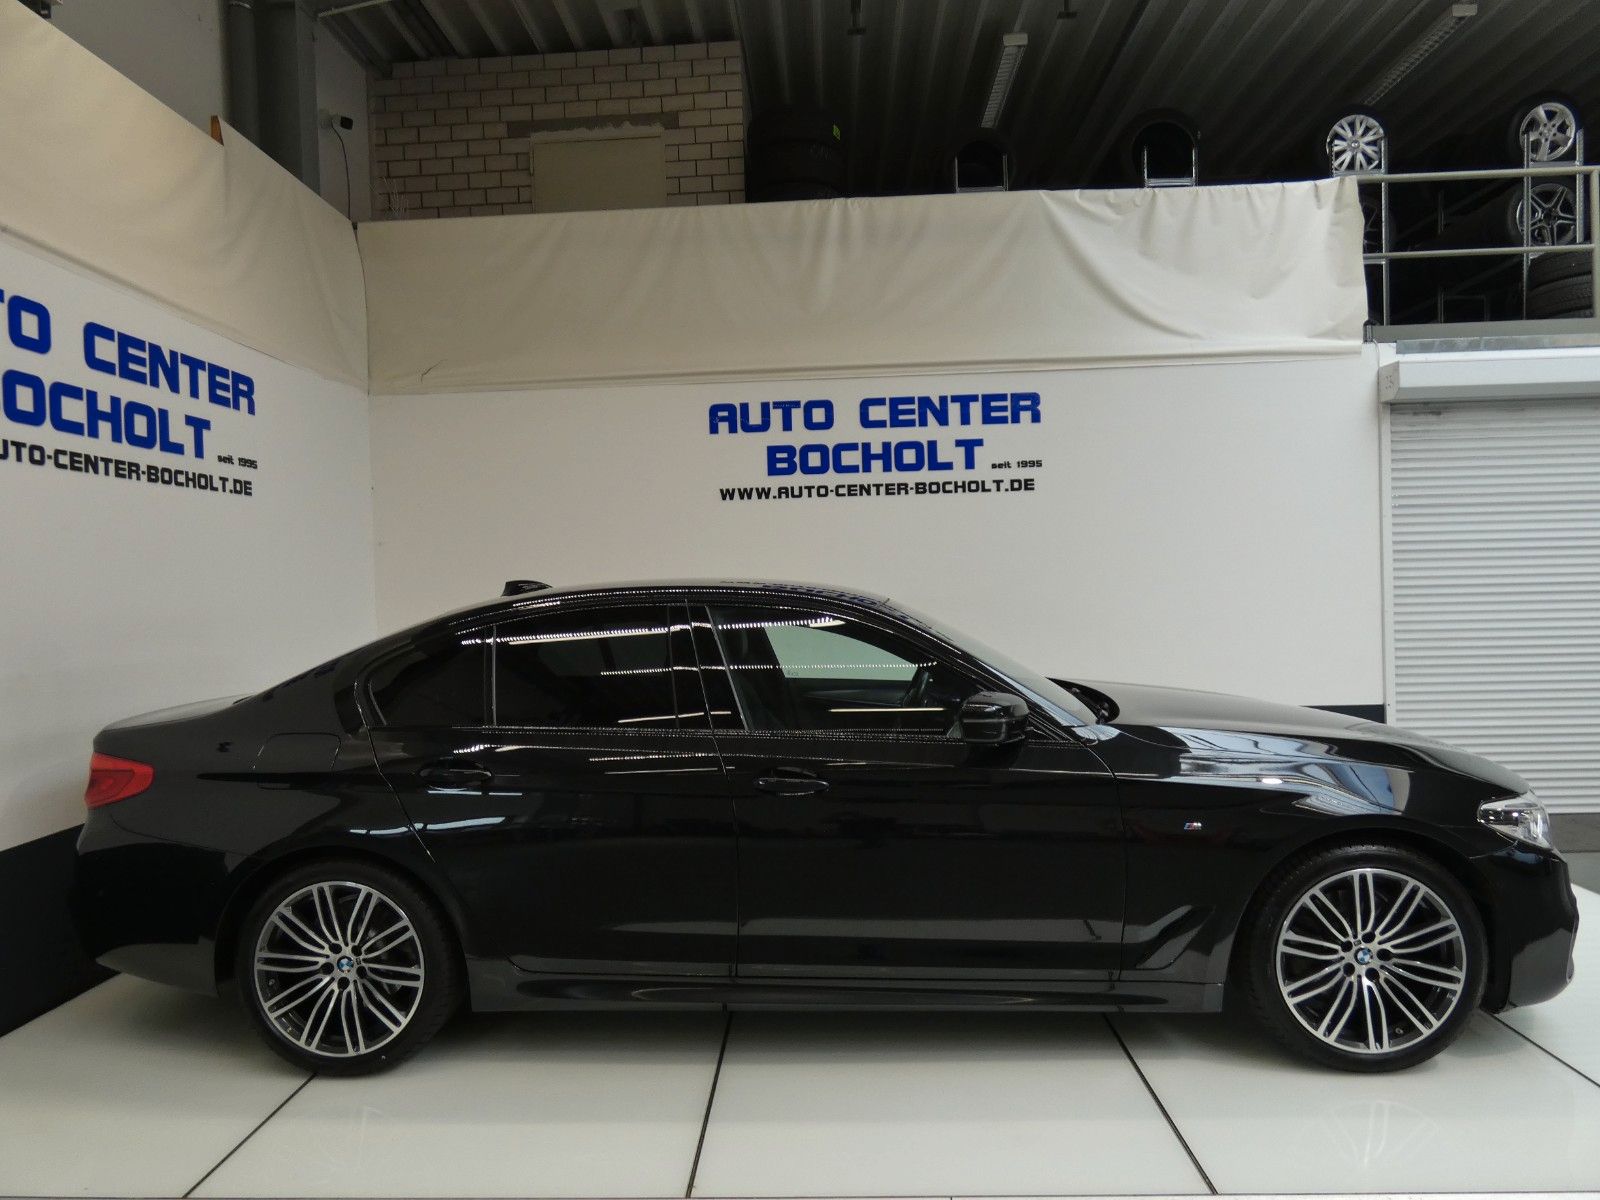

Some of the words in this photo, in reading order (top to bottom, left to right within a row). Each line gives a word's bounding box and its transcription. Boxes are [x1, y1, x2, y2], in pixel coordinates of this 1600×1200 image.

[0, 288, 51, 355] O
[83, 321, 255, 416] CENTER
[2, 369, 211, 459] OCHOLT
[238, 456, 258, 470] 1995
[708, 399, 834, 434] AUTO
[859, 391, 1041, 429] CENTER
[766, 438, 984, 476] BOCHOLT
[991, 460, 1012, 469] seit
[1016, 459, 1043, 468] 1995
[719, 478, 1036, 501] WWW.AUTO-CENTER-BOCHOLT.DE
